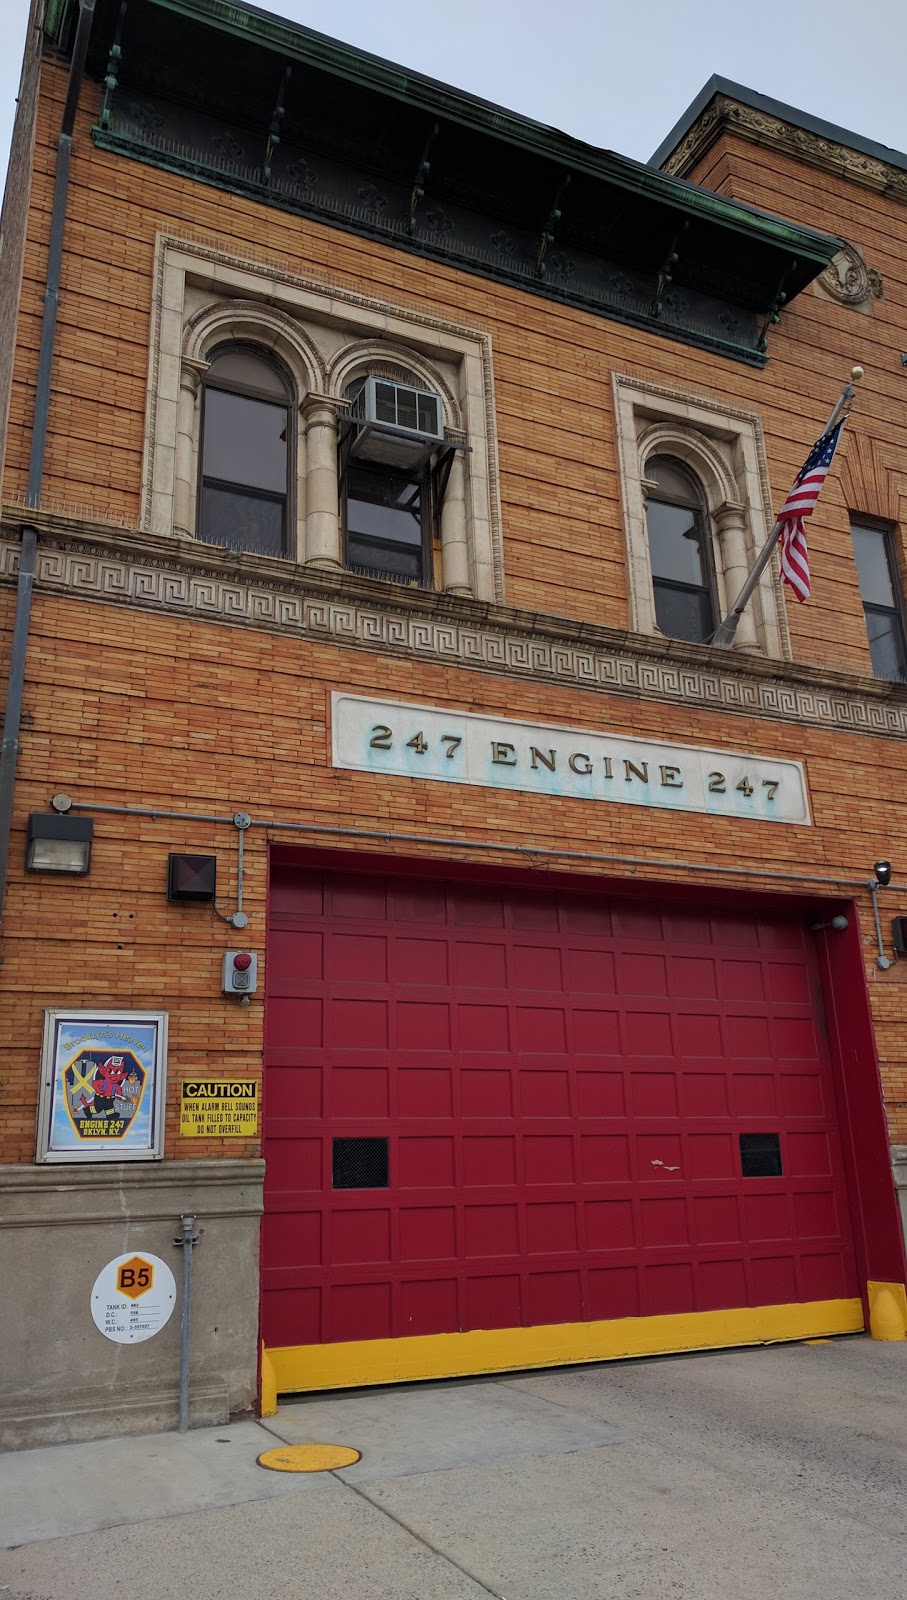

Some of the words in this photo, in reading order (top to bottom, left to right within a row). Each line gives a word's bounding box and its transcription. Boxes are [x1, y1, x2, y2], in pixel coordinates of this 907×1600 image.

[369, 725, 462, 758] 247
[490, 741, 684, 789] ENGINE
[708, 771, 779, 800] 247
[63, 1030, 113, 1051] Brooklyn's
[115, 1031, 148, 1053] Heaven
[123, 1086, 139, 1094] HOT
[186, 1083, 253, 1097] CAUTION
[115, 1103, 137, 1111] STUFF
[184, 1102, 199, 1111] WHEN
[201, 1102, 219, 1111] ALARM
[221, 1103, 233, 1111] BELL
[235, 1102, 255, 1111] SOUNDS
[182, 1113, 190, 1122] OIL
[192, 1113, 205, 1122] TANK
[207, 1113, 223, 1122] FILLED
[225, 1113, 231, 1122] TO
[233, 1113, 256, 1122] CAPACITY
[80, 1120, 109, 1129] ENGINE
[110, 1120, 124, 1129] 247
[197, 1125, 204, 1133] DO
[206, 1125, 217, 1133] NOT
[219, 1125, 241, 1133] OVERFILL
[120, 1268, 149, 1288] B5
